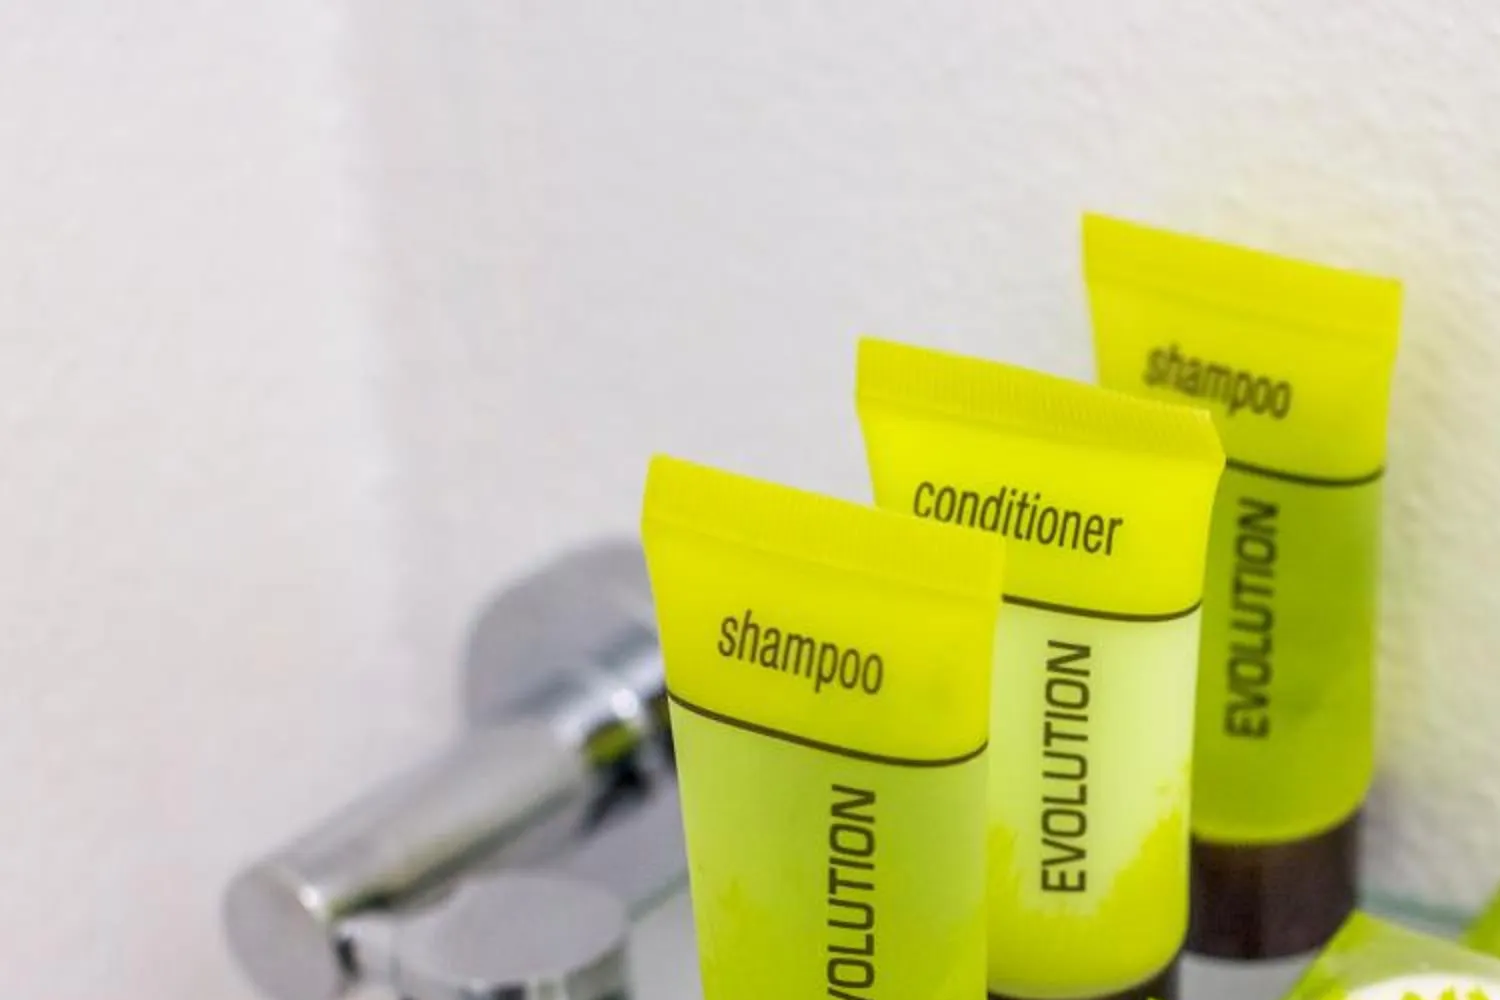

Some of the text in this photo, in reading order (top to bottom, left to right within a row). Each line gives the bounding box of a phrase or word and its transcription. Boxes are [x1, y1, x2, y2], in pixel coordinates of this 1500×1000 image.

[1145, 344, 1292, 420] shampoo
[913, 480, 1124, 556] conditioner
[717, 609, 885, 696] shampoo
[1224, 497, 1280, 740] EVOLUTION
[1041, 639, 1091, 895] EVOLUTION
